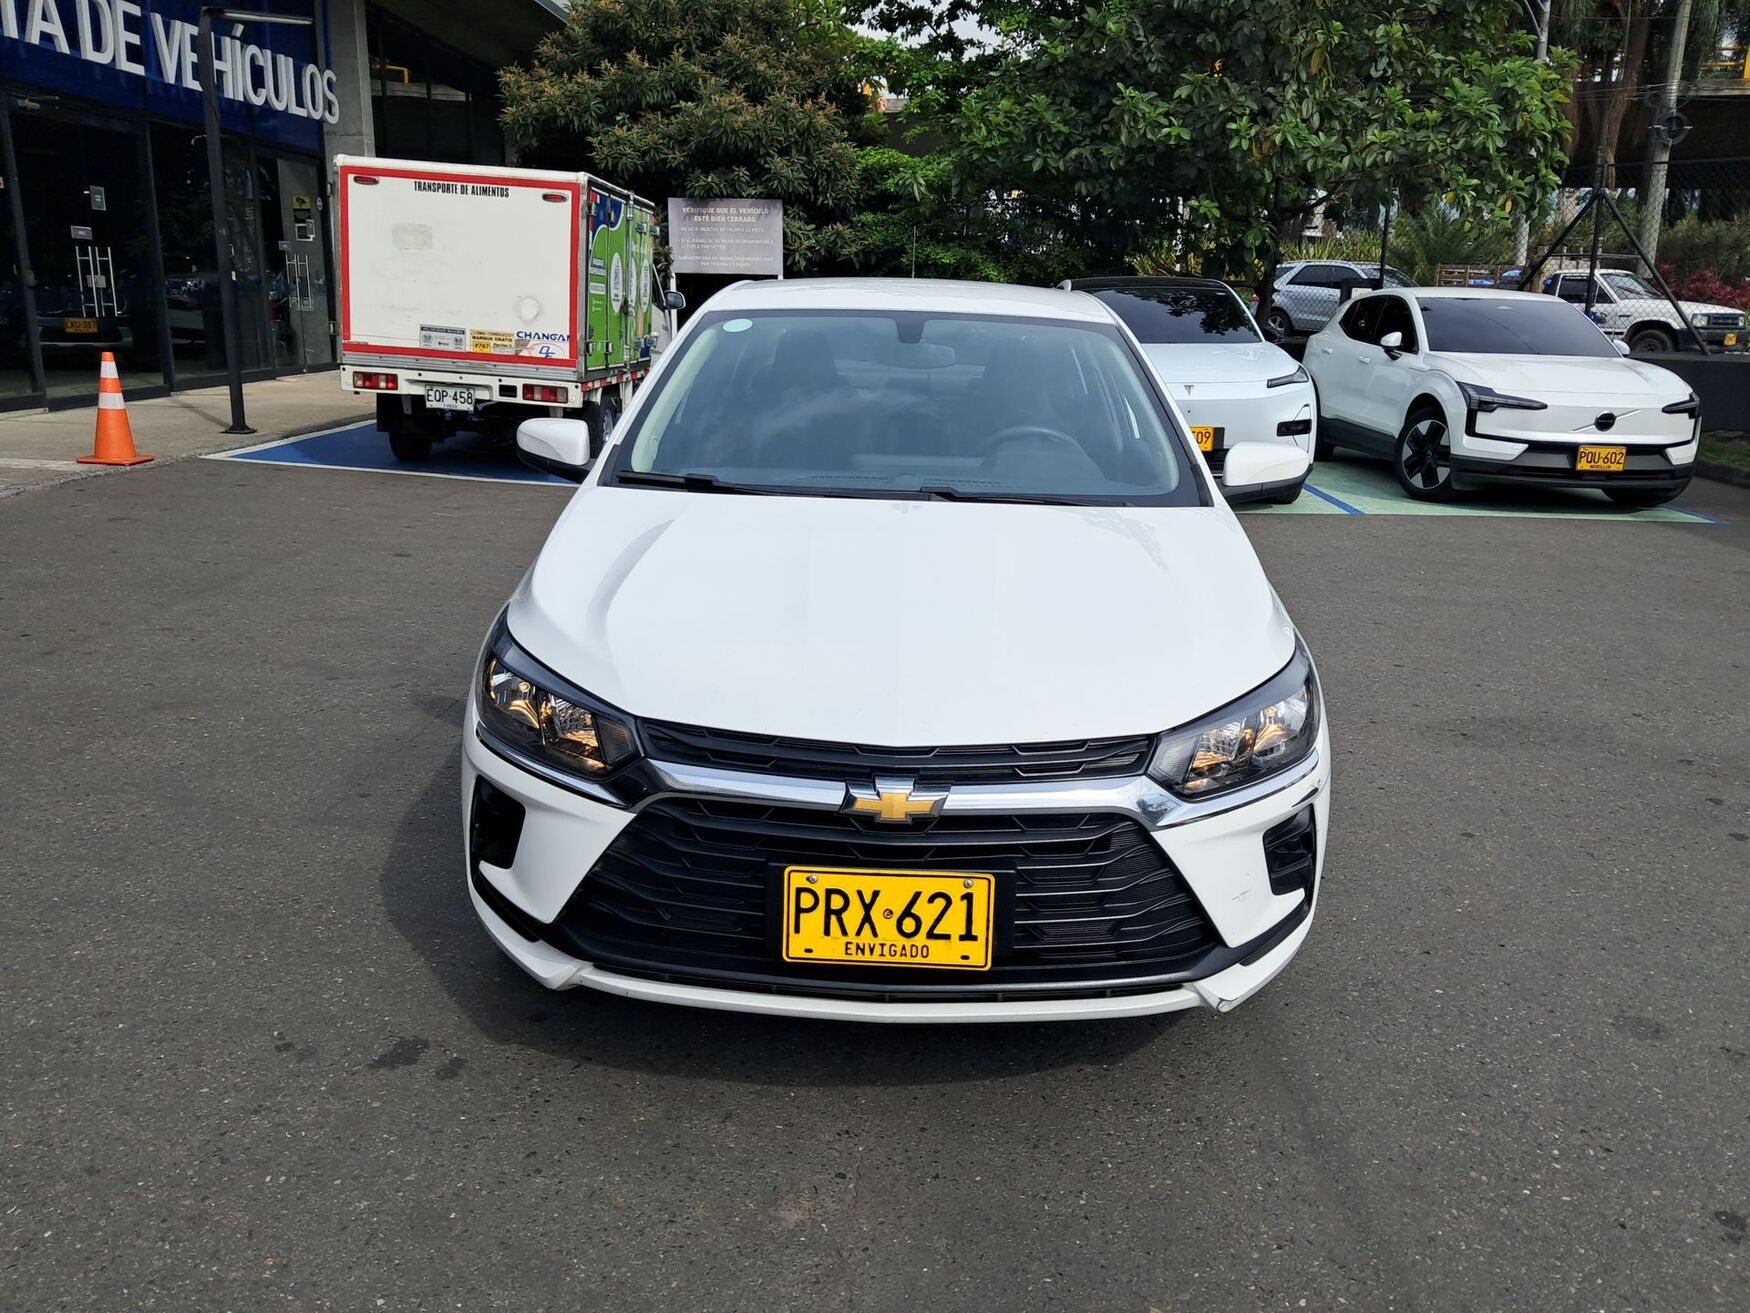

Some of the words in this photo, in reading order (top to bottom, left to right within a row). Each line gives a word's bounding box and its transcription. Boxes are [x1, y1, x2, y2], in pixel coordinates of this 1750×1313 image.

[76, 0, 145, 76] DE
[151, 12, 340, 125] VEHÍCULOS
[414, 181, 458, 194] TRANSPORTE
[460, 184, 469, 195] DE
[471, 185, 510, 198] ALIMENTOS
[1192, 430, 1211, 444] 09
[845, 941, 930, 959] ENVIGADO
